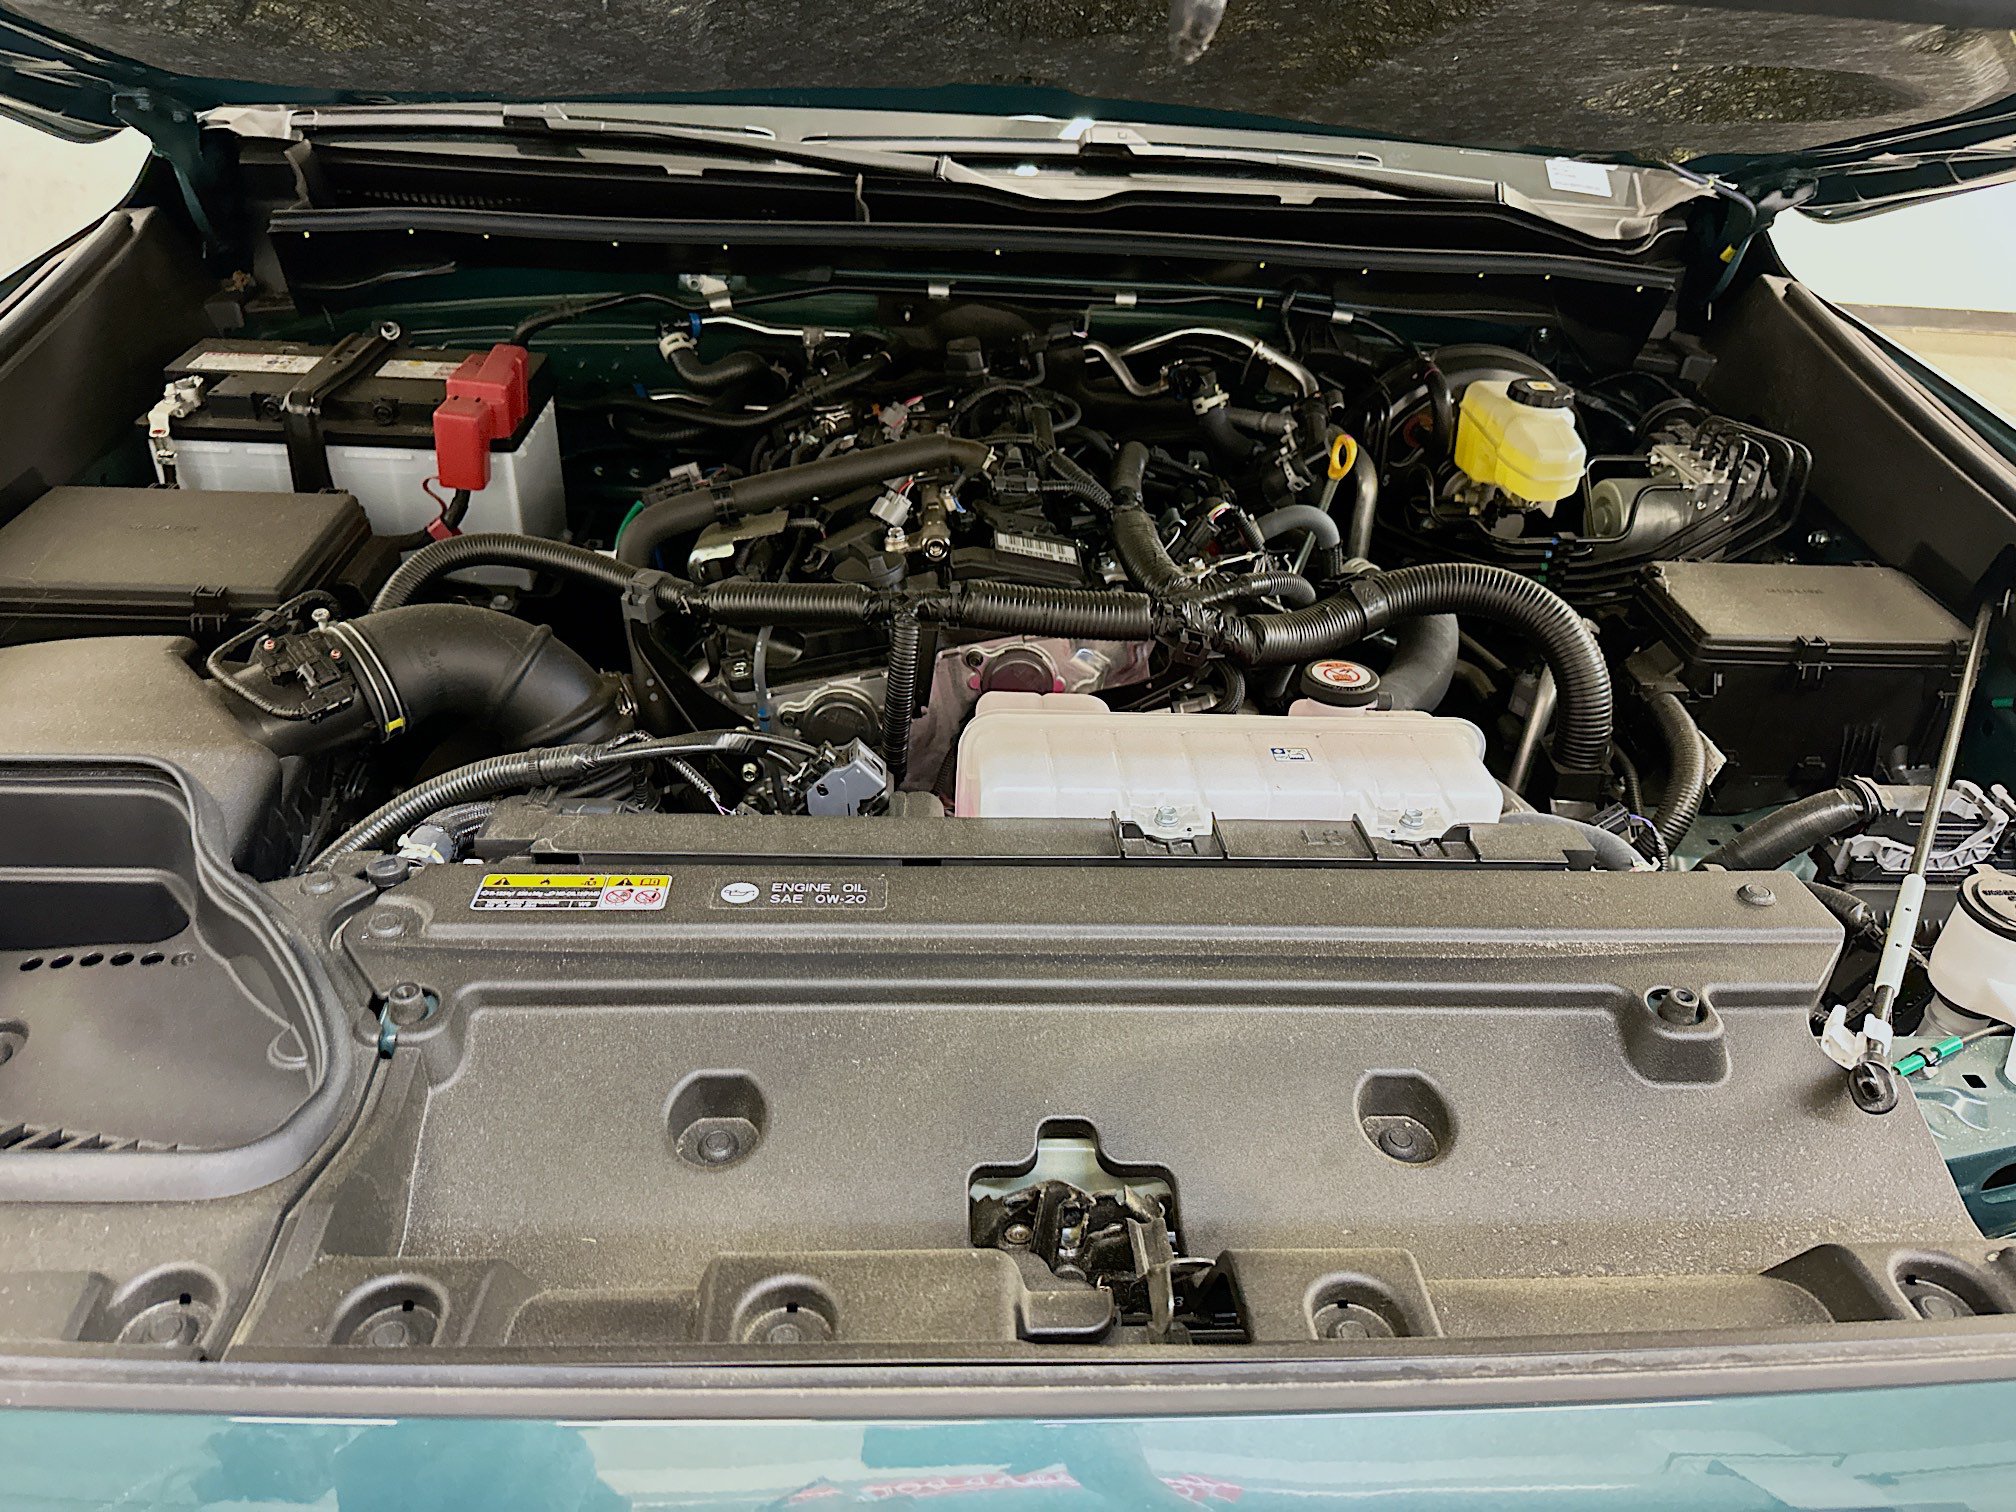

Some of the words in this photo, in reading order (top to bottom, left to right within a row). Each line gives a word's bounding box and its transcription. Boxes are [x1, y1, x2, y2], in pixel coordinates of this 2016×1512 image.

[771, 882, 831, 893] ENGINE
[842, 883, 868, 893] OIL
[769, 894, 804, 904] SAE
[814, 894, 867, 904] 0W-20
